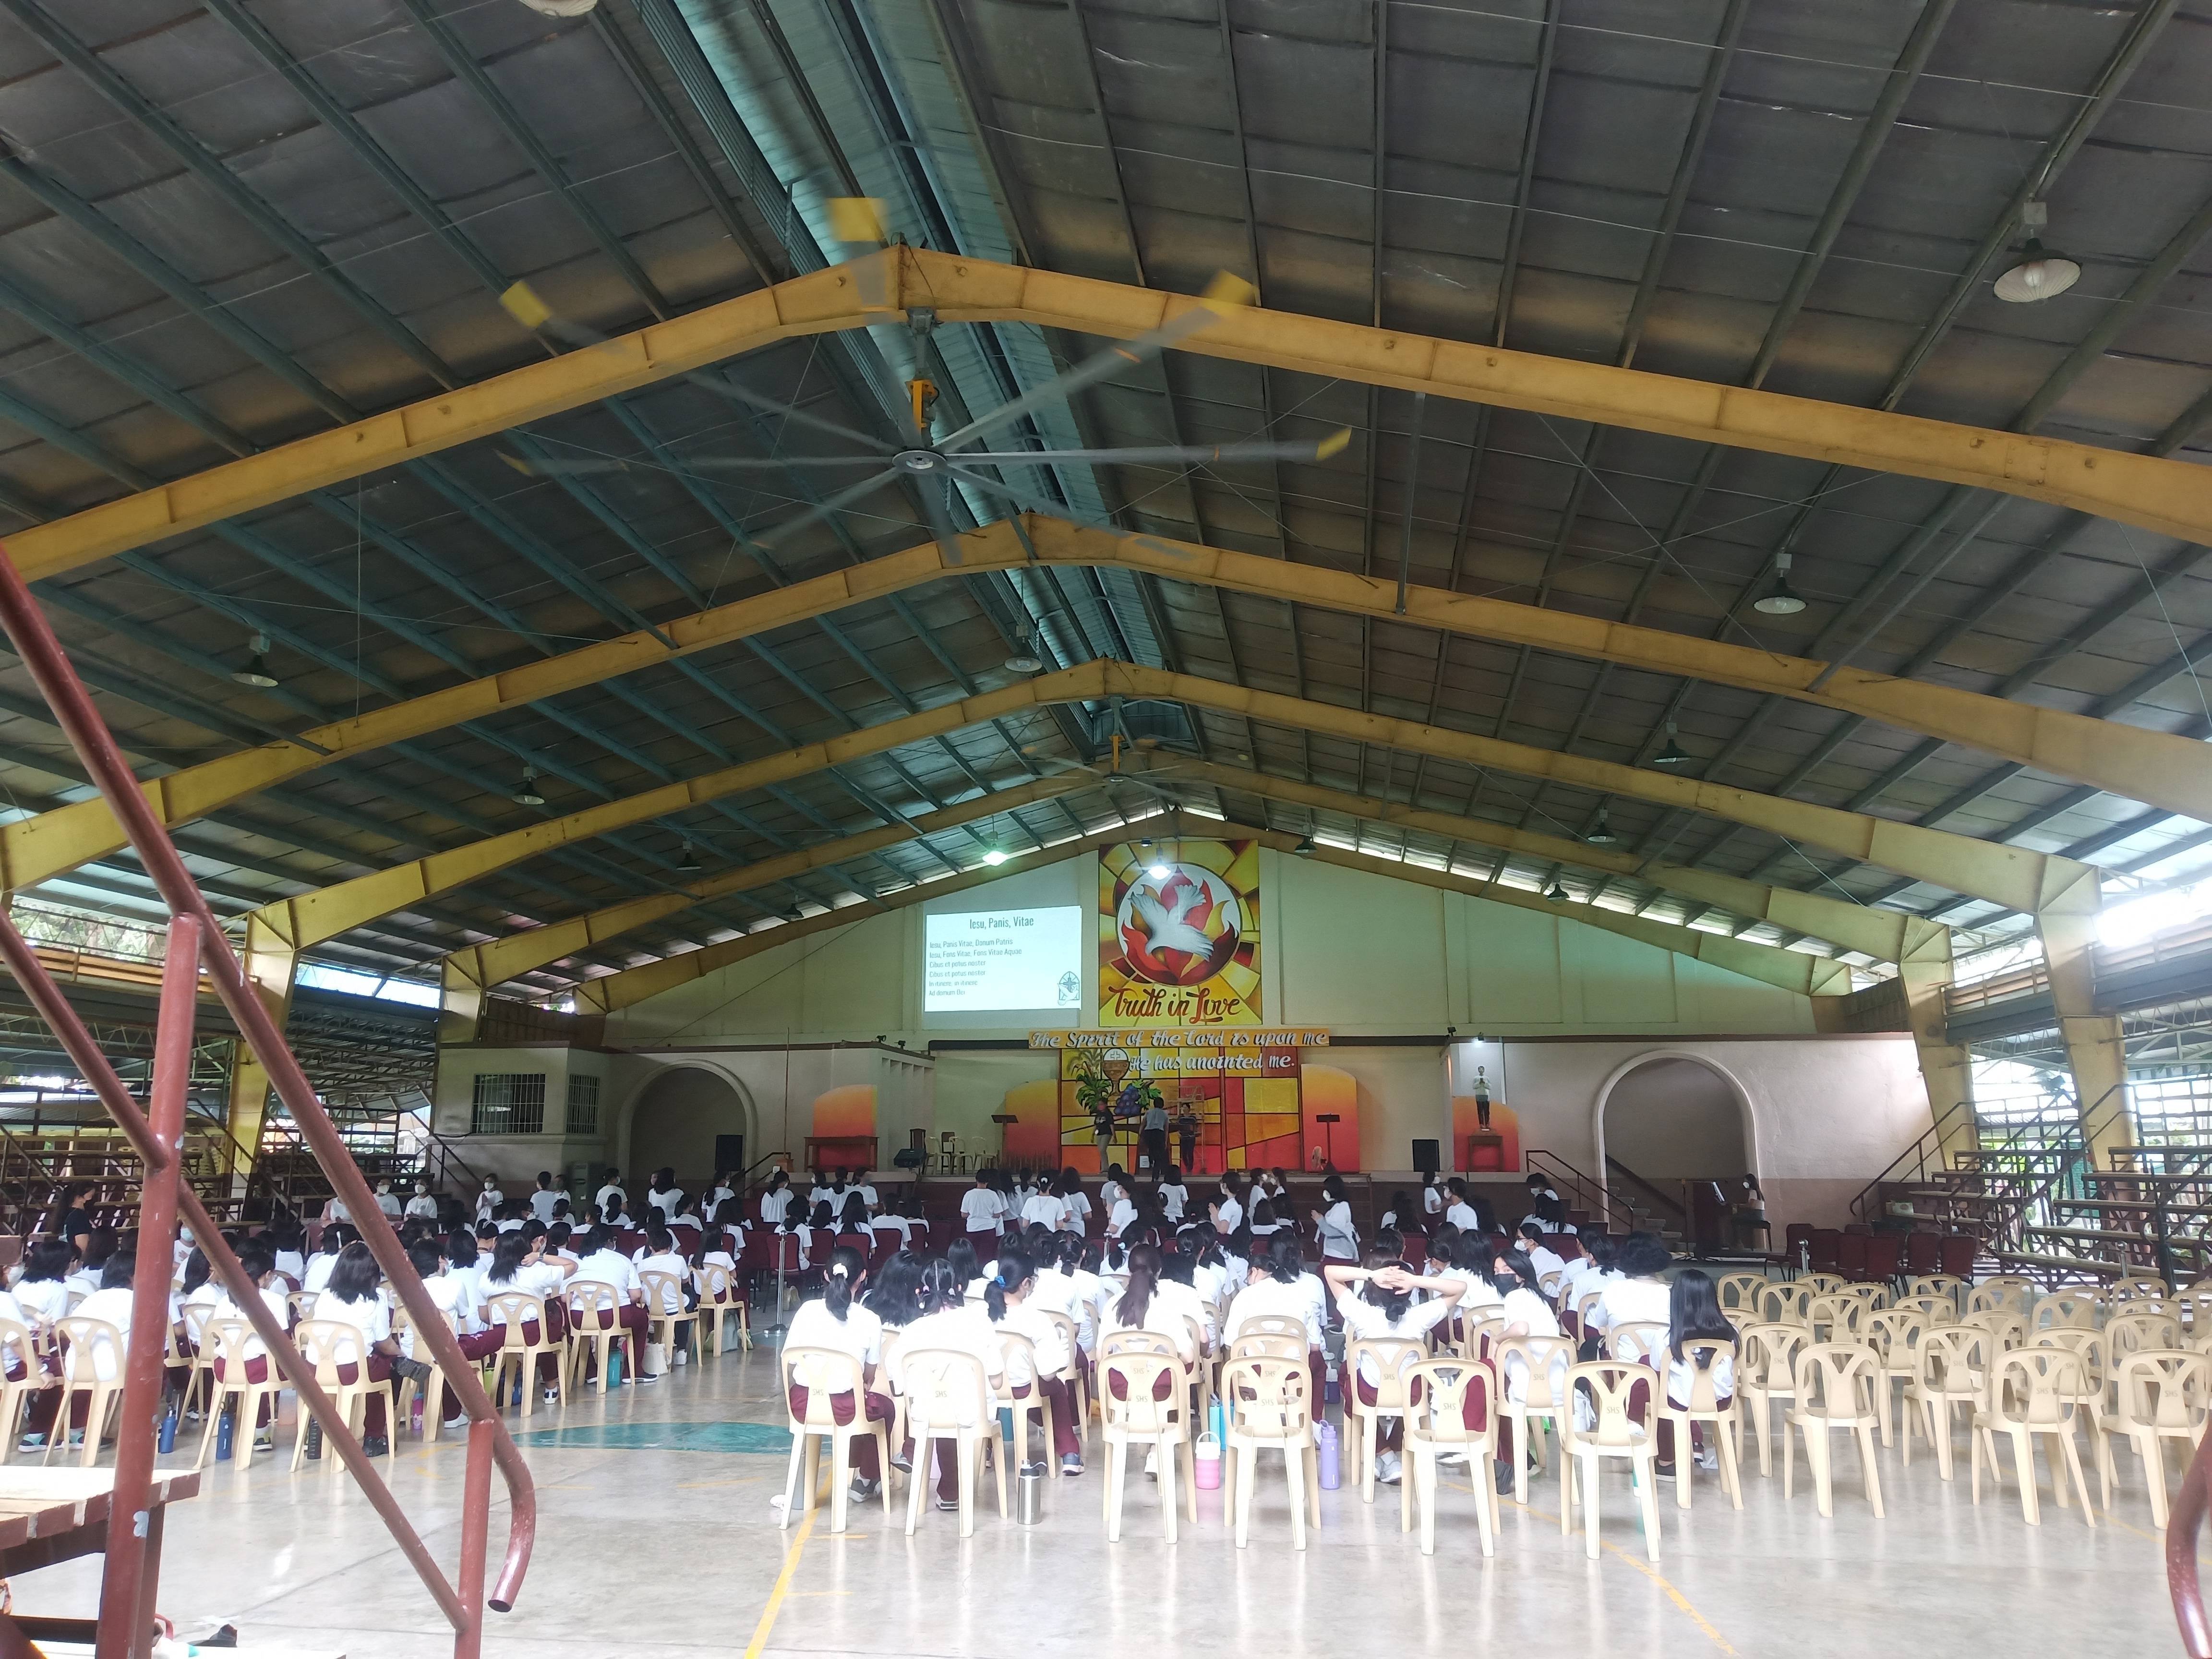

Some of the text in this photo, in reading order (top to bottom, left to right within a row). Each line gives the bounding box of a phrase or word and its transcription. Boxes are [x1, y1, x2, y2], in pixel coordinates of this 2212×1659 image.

[970, 916, 1034, 929] Iesu, Panis, Vitae
[1108, 986, 1243, 1024] Truth in Love
[1030, 1031, 1060, 1047] The
[1066, 1032, 1123, 1048] Spirit
[1126, 1031, 1145, 1047] of
[1151, 1030, 1181, 1047] the
[1183, 1030, 1225, 1046] Lord
[1230, 1032, 1250, 1046] is
[1253, 1032, 1297, 1047] upon
[1129, 1053, 1295, 1071] He has anointed me.
